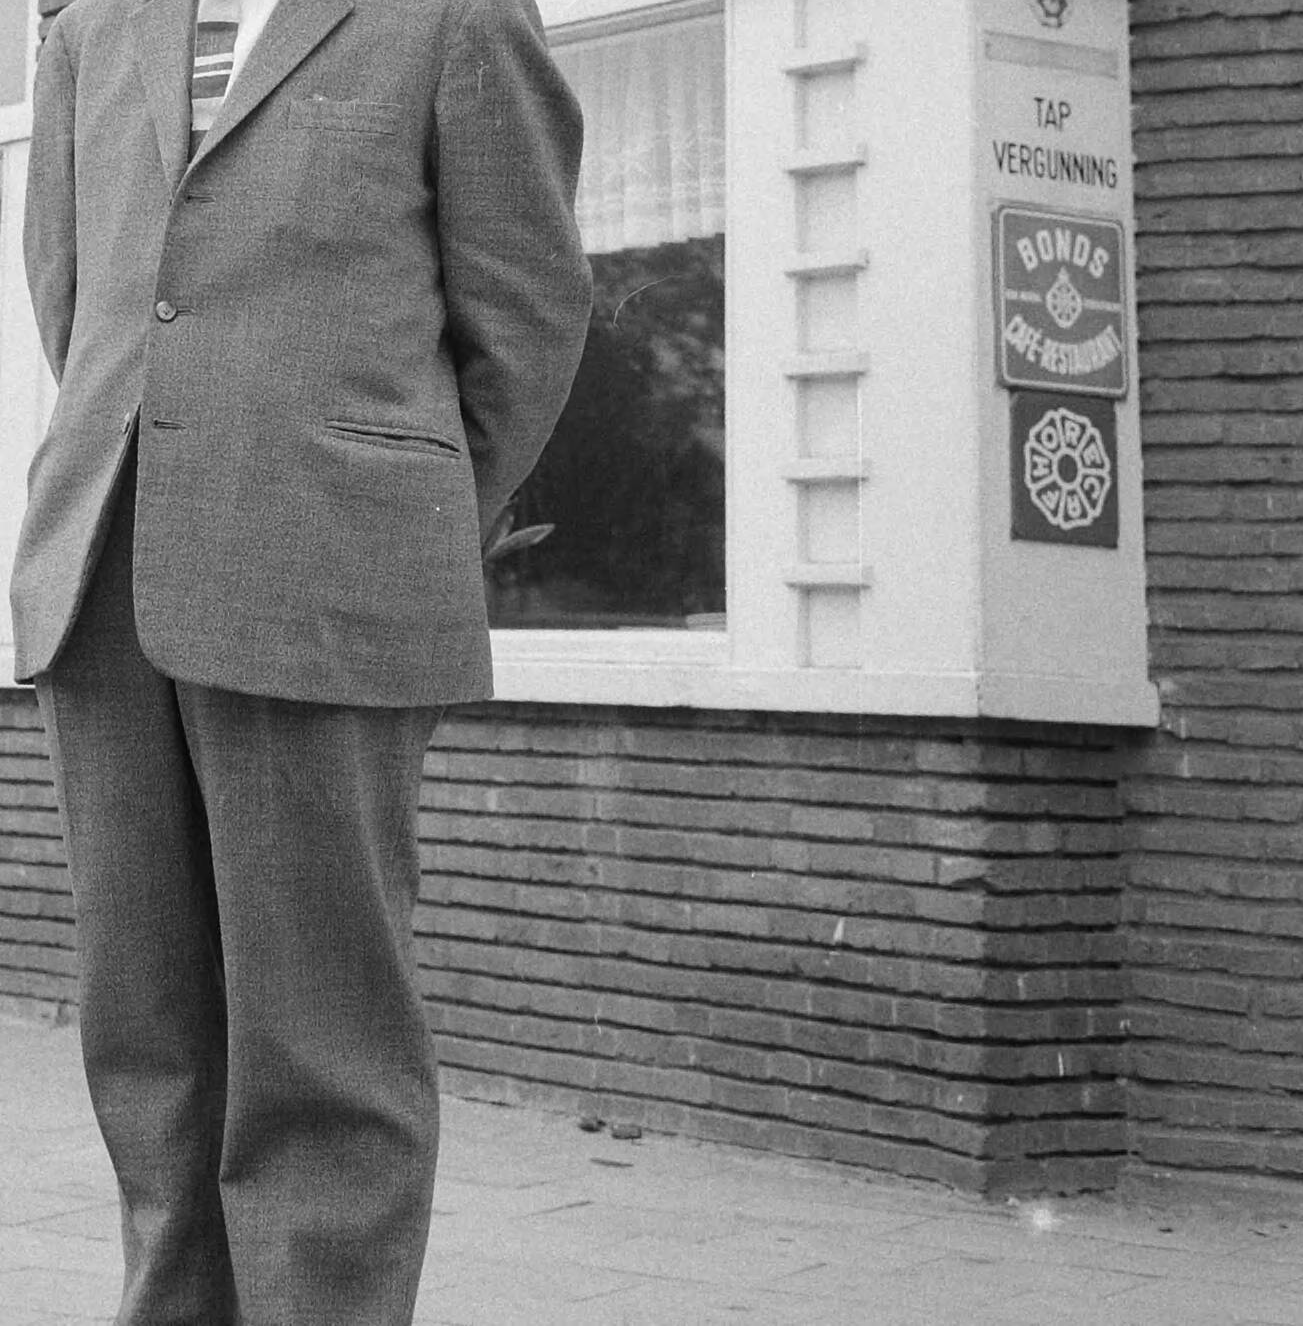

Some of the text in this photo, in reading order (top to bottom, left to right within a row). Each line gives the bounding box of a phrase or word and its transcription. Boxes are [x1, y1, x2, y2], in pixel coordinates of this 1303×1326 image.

[1033, 96, 1072, 129] TAP
[993, 139, 1117, 188] VERGUNNING
[1016, 227, 1110, 279] BONDS
